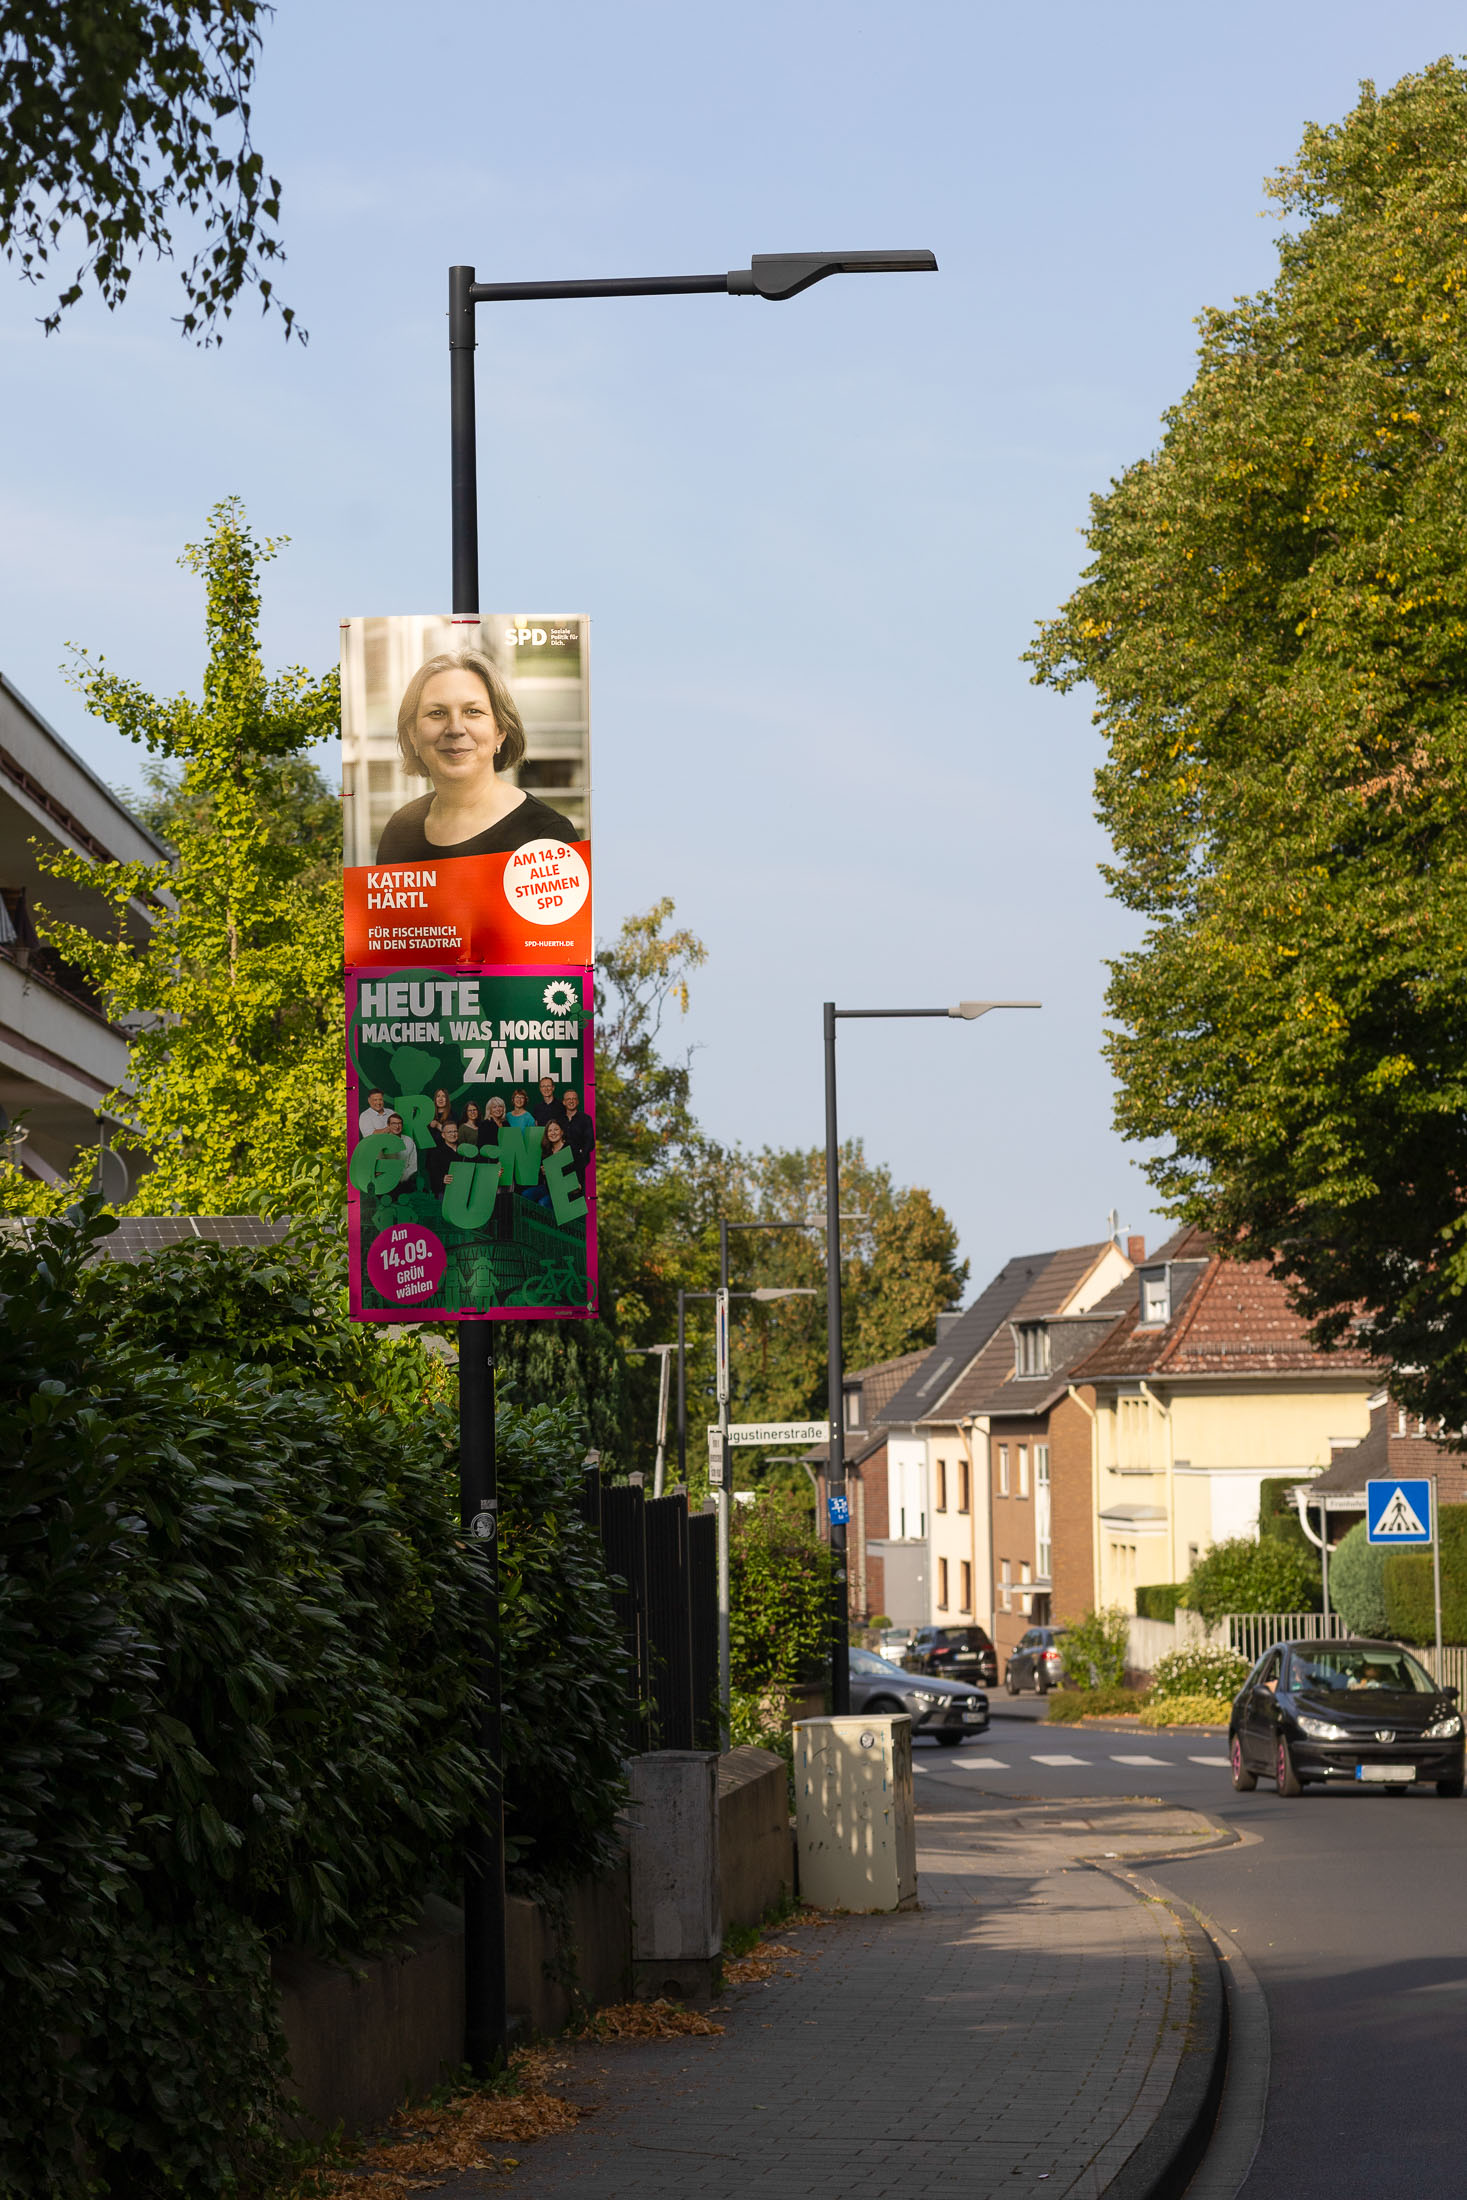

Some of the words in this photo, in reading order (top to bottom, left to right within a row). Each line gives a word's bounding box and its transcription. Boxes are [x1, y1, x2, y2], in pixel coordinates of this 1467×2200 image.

[504, 628, 548, 646] SPD
[513, 852, 537, 867] AM
[538, 847, 571, 862] 14.9:
[367, 870, 437, 889] KATRIN
[530, 863, 560, 880] ALLE
[515, 875, 580, 898] STIMMEN
[367, 888, 429, 910] HÄRTL
[537, 895, 563, 910] SPD
[368, 926, 390, 938] FÜR
[392, 925, 457, 938] FISCHENICH
[368, 940, 381, 950] IN
[383, 939, 407, 950] DEN
[409, 937, 463, 949] STADTRAT
[361, 981, 481, 1018] HEUTE
[362, 1022, 445, 1045] MACHEN,
[449, 1020, 493, 1041] WAS
[499, 1020, 579, 1041] MORGEN
[463, 1040, 578, 1083] ZÄHLT
[391, 1229, 408, 1243] Am
[380, 1239, 433, 1271] 14.09.
[396, 1265, 425, 1285] GRÜN
[396, 1280, 434, 1300] wählen
[727, 1427, 823, 1444] ugustinerstraße
